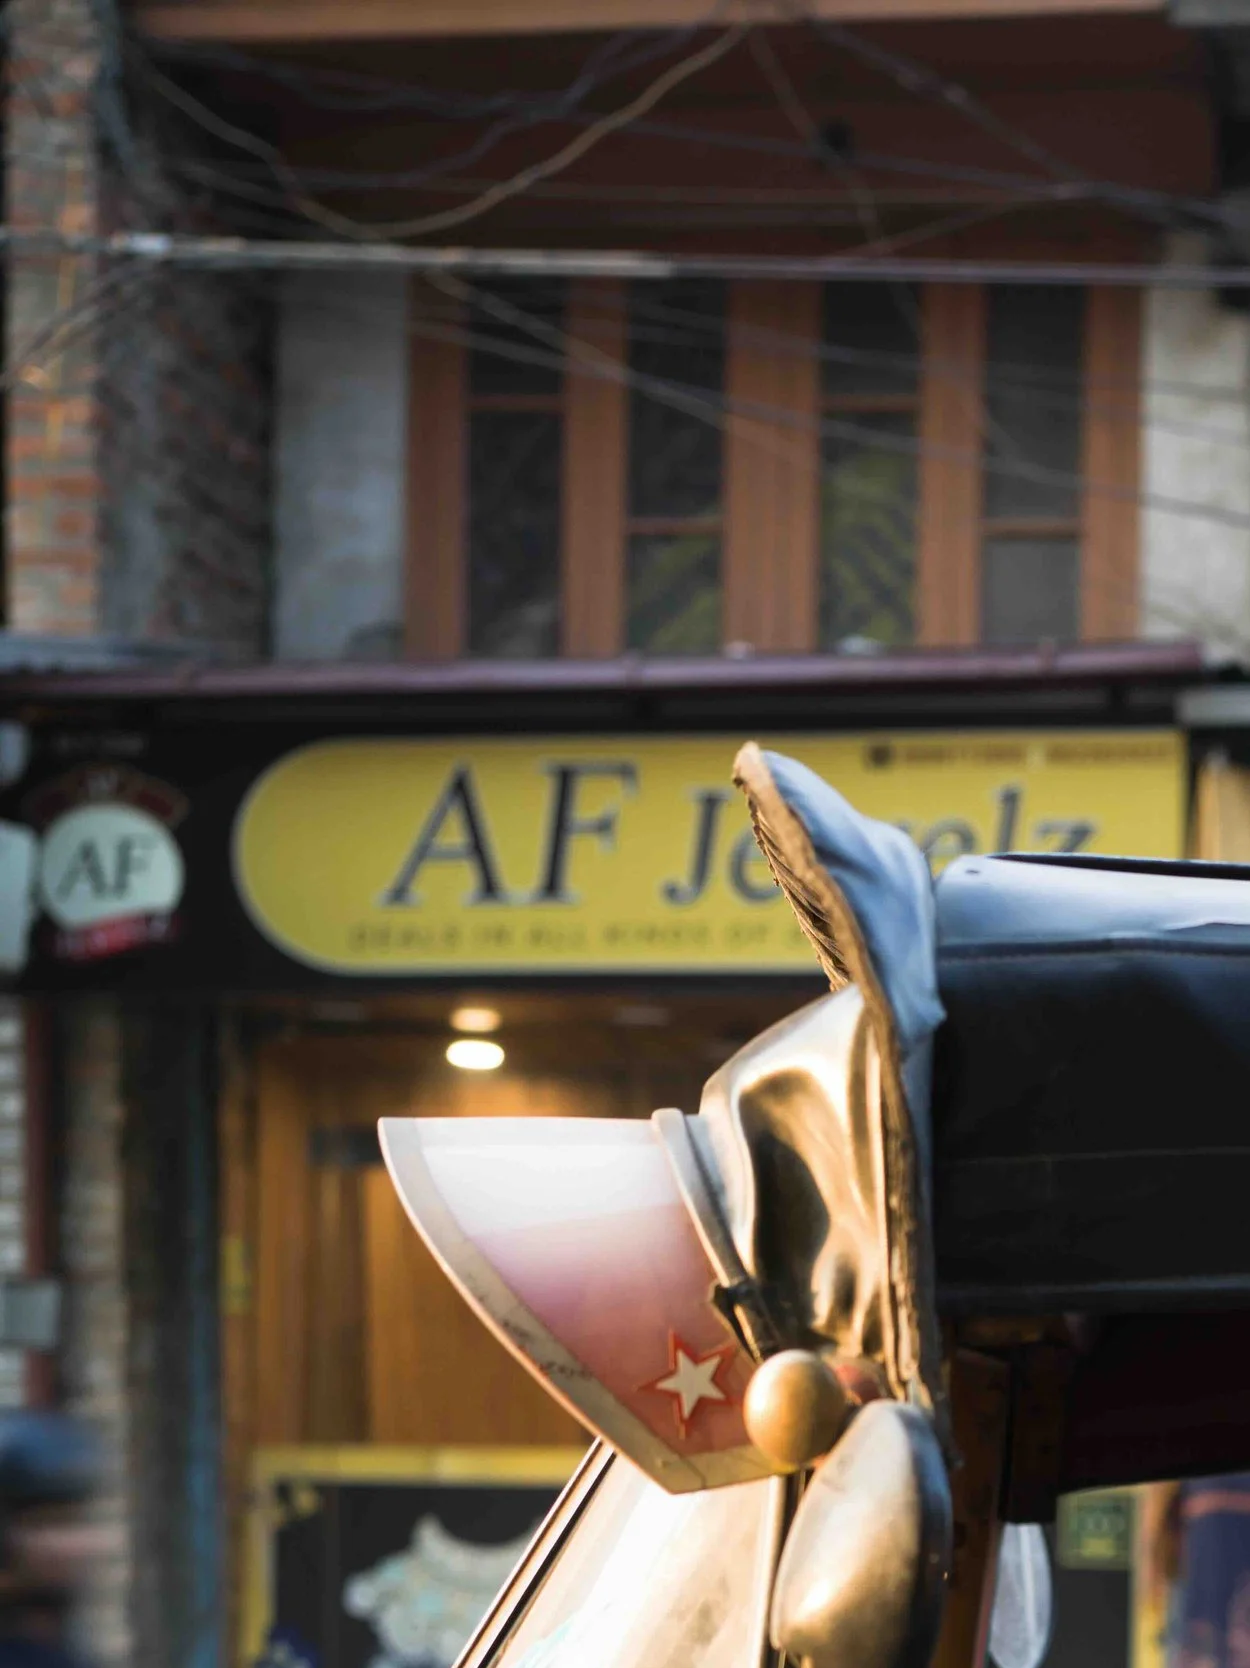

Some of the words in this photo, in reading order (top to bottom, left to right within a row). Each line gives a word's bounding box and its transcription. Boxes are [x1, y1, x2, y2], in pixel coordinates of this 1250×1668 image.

[55, 834, 158, 900] AF
[374, 760, 638, 907] AF
[660, 784, 1096, 907] Jeel
